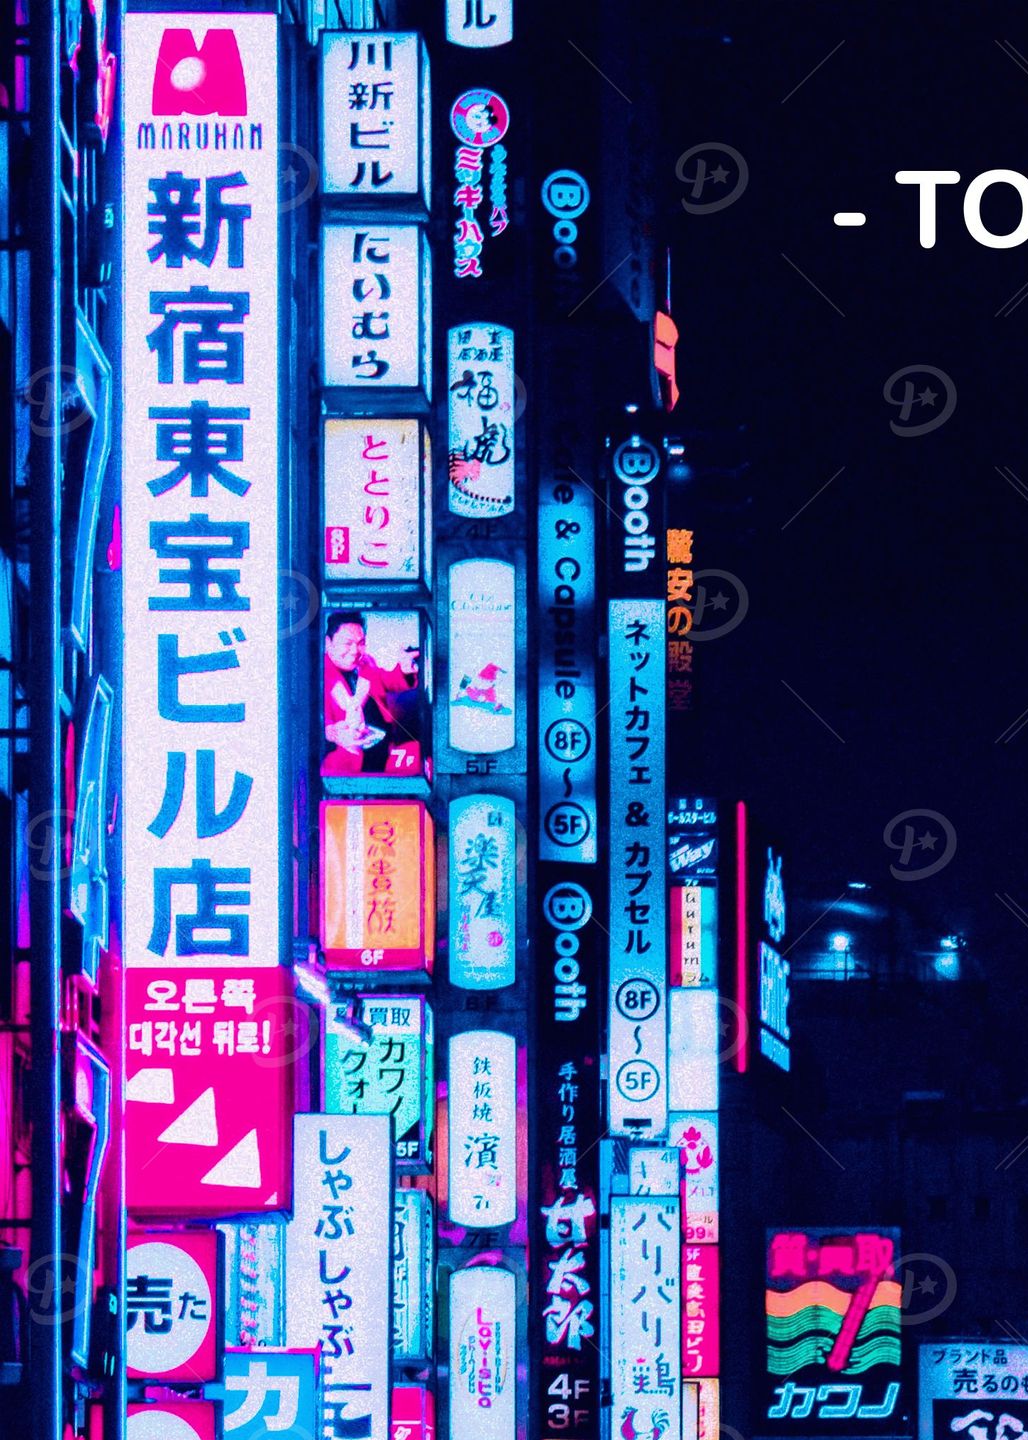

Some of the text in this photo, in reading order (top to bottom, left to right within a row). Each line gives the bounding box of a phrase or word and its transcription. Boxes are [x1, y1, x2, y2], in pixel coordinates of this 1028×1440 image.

[347, 41, 394, 188] 川新ビル
[351, 231, 391, 380] にいむら
[146, 171, 253, 957] 新宿東宝ビル店
[360, 434, 390, 569] ととりこ
[614, 437, 660, 573] Booth
[624, 620, 652, 784] ネットカフェ
[360, 950, 384, 966] 6F
[543, 882, 592, 1021] Booth
[624, 842, 652, 955] カプセル
[129, 1020, 271, 1056] 대각선 뒤로!
[144, 979, 256, 1014] 오른쪽
[472, 1056, 493, 1122] 鉄板焼
[557, 1061, 579, 1190] 手作り居酒屋
[315, 1130, 355, 1359] しゃぶしゃぶ
[541, 1194, 596, 1350] 甘太郎
[631, 1206, 677, 1397] バリバリ鶏
[548, 1373, 591, 1400] 4F
[548, 1403, 591, 1429] 3F
[767, 1382, 900, 1419] カワノ
[931, 1347, 1008, 1366] ブランド品
